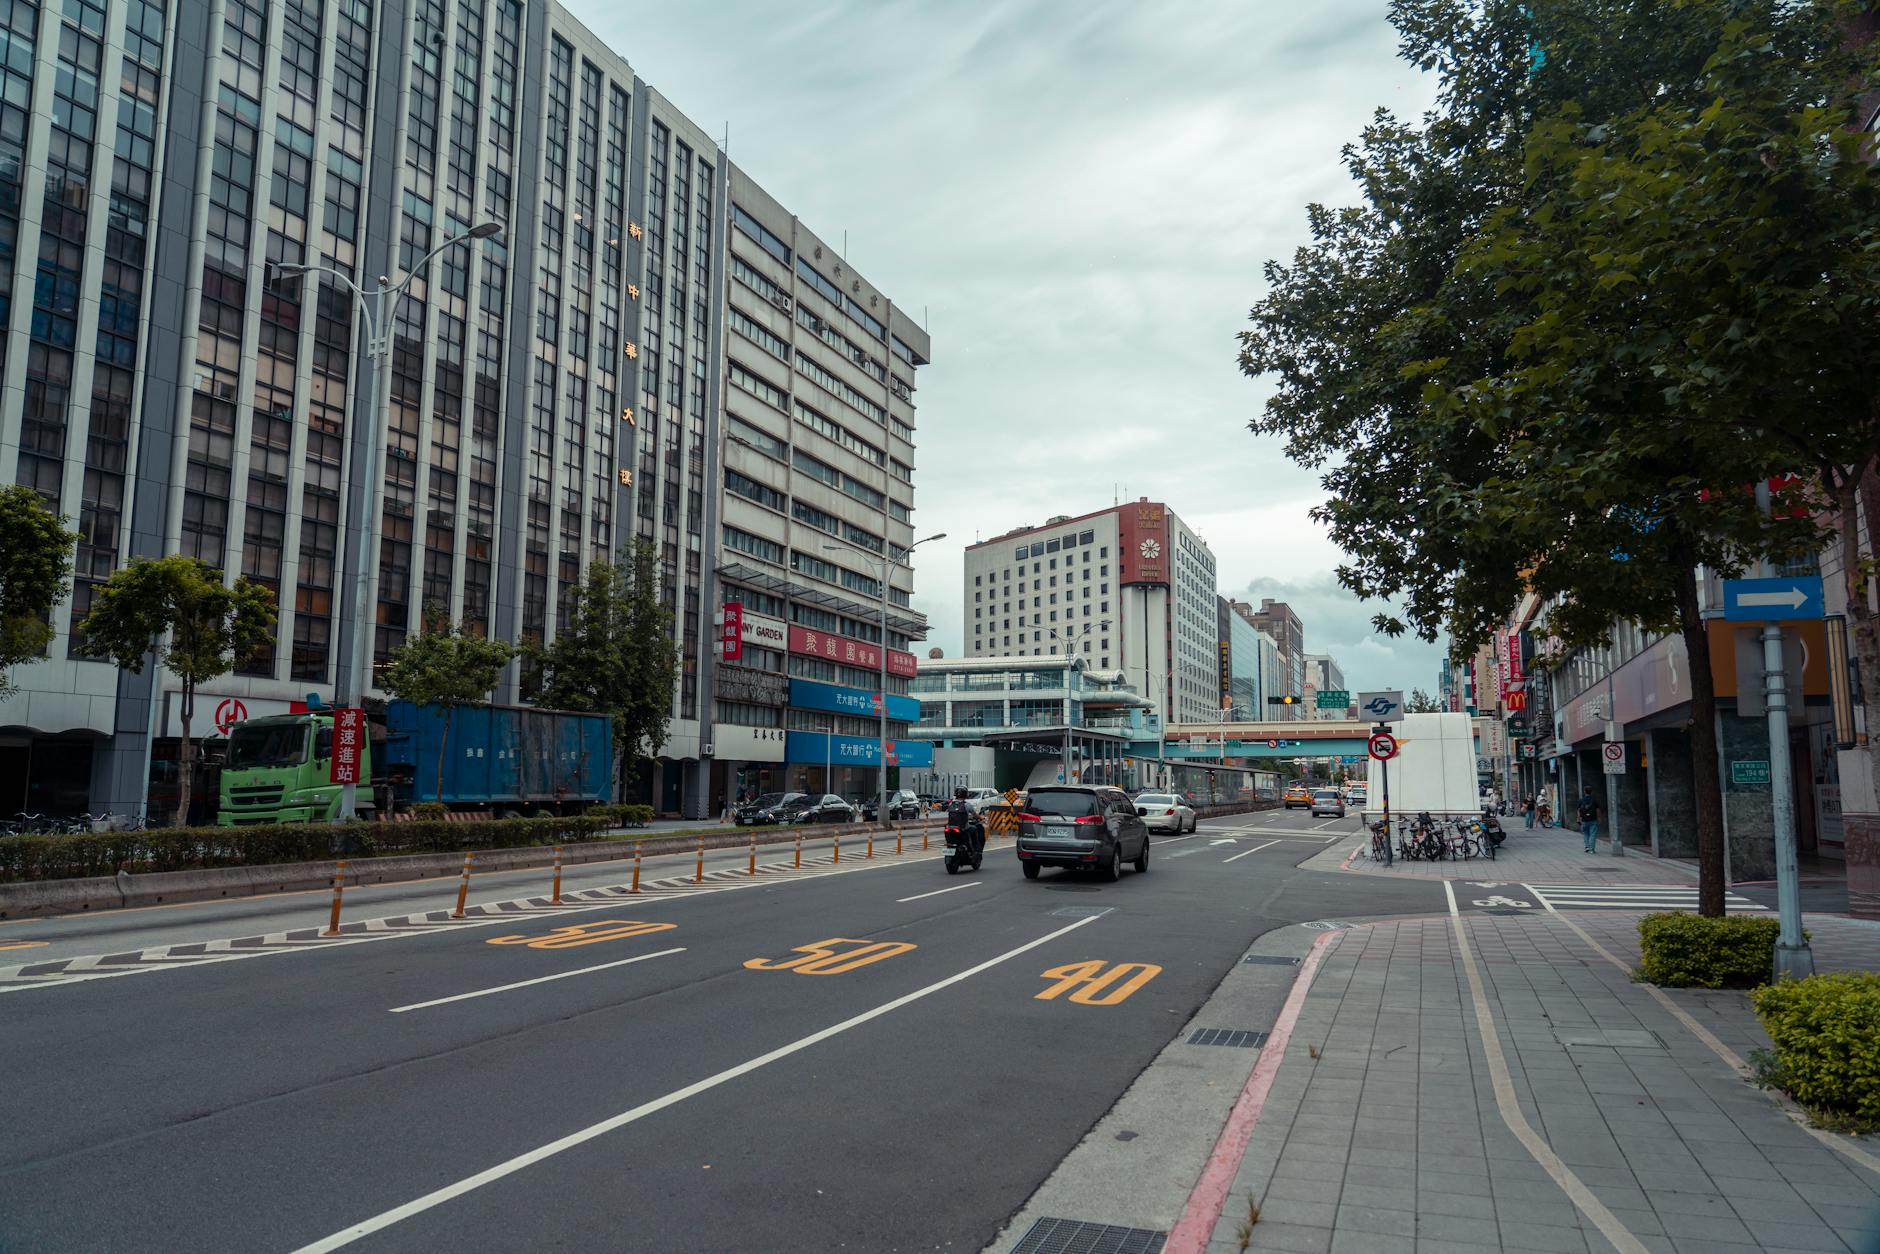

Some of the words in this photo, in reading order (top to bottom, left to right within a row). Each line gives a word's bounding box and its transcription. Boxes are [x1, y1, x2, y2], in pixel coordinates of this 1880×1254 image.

[619, 222, 643, 488] 新中華大樓
[756, 626, 784, 641] GARDEN
[337, 711, 357, 781] 減速進站
[840, 743, 865, 757] 元大銀行
[485, 919, 678, 949] 50
[742, 937, 918, 976] 50
[1033, 959, 1163, 1006] 40
